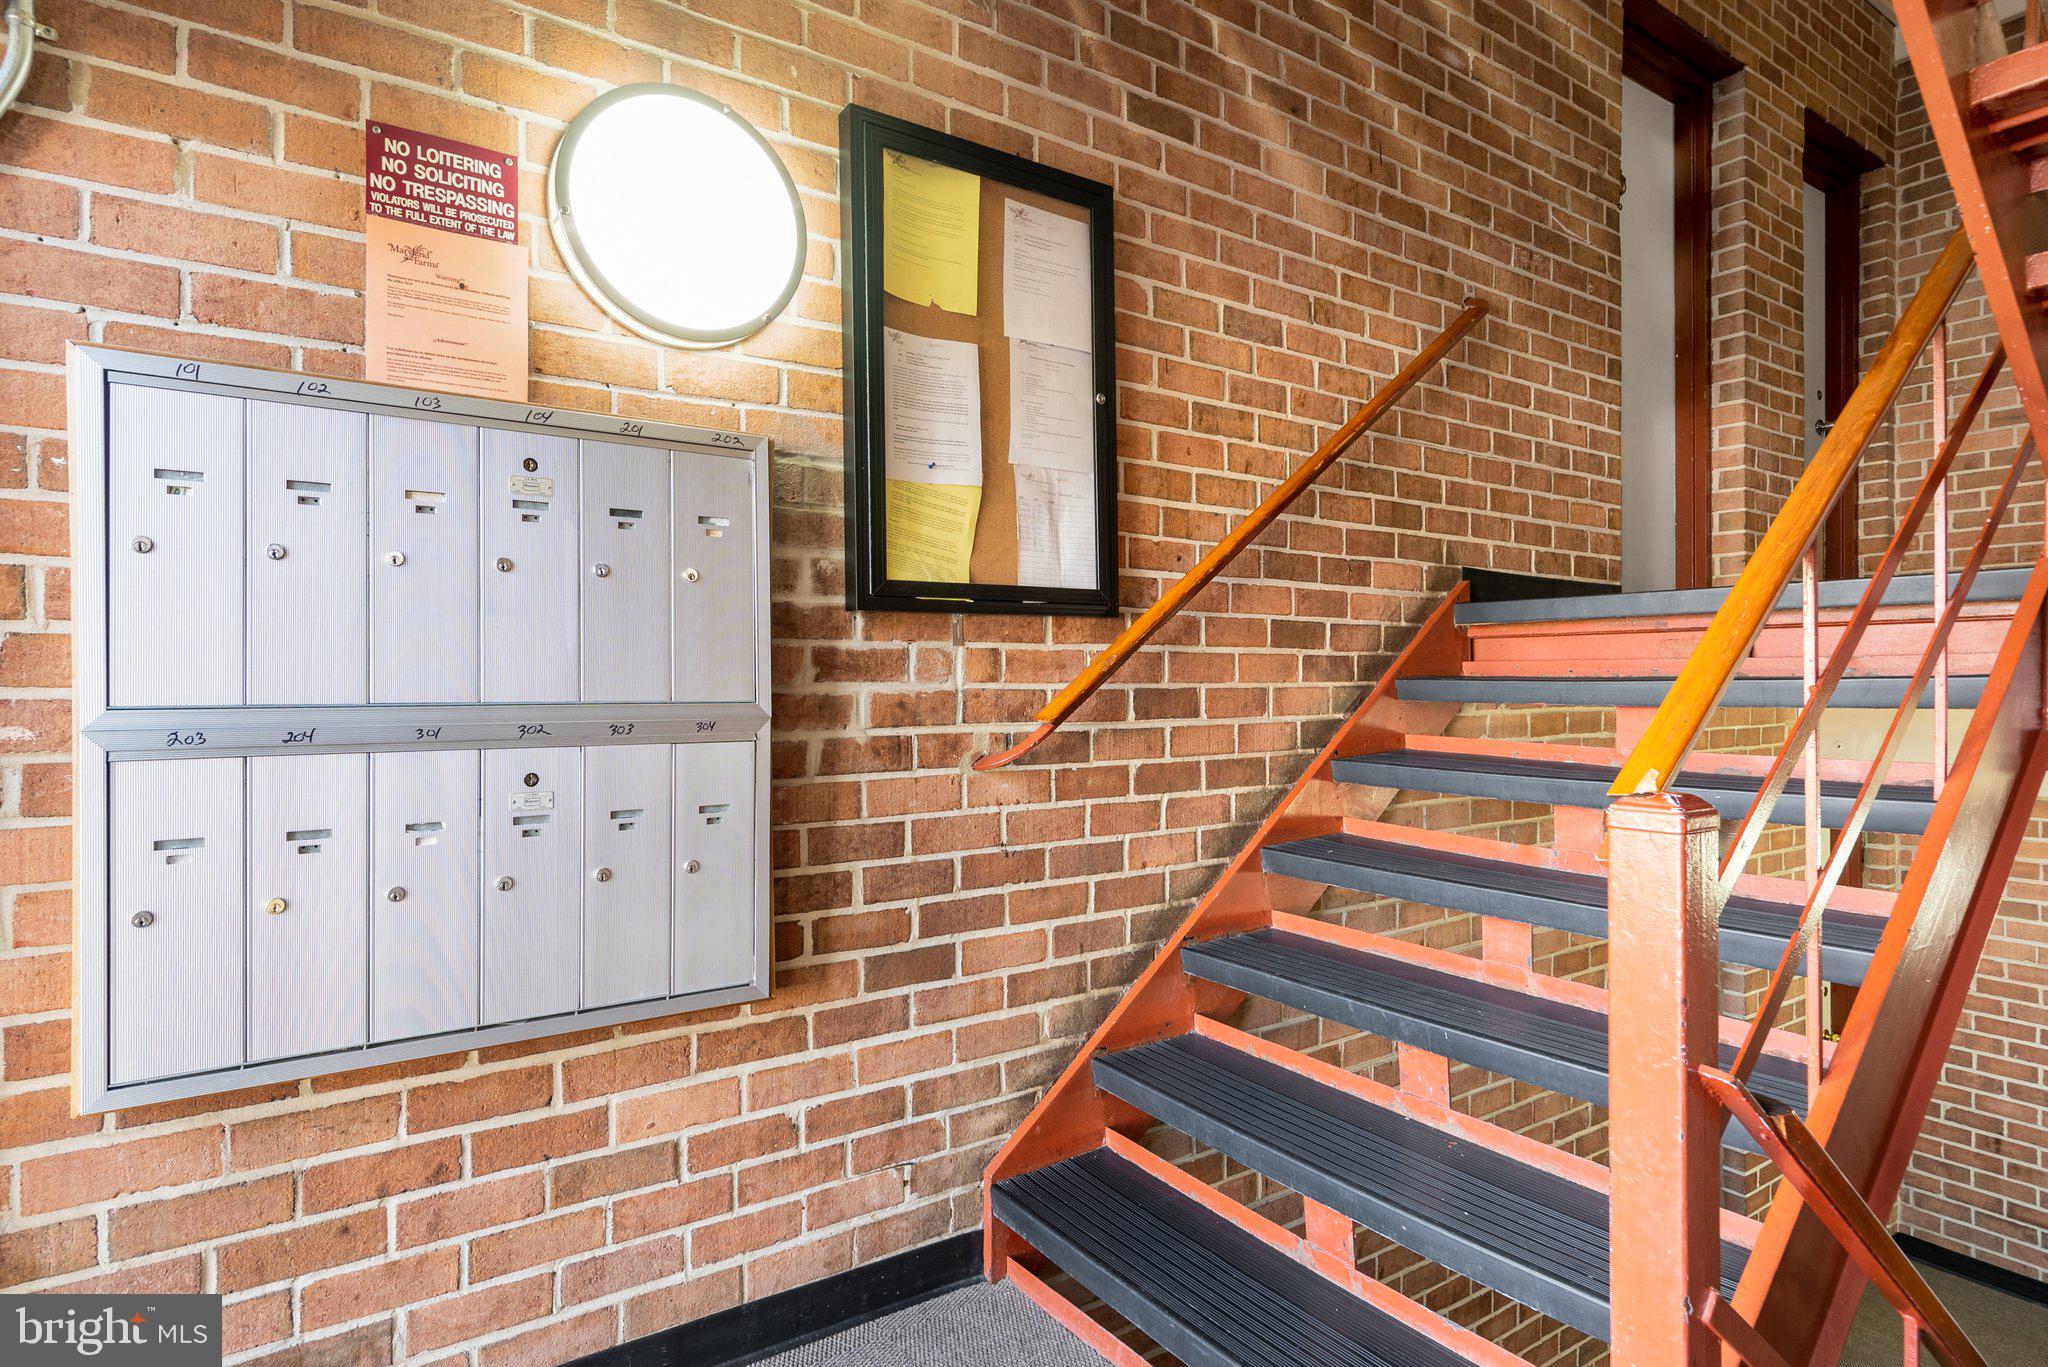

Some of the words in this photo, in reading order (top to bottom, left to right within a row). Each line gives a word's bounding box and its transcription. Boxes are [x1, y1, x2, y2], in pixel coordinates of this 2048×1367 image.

[384, 138, 410, 157] NO
[417, 145, 502, 179] LOITERING
[381, 156, 407, 175] NO
[414, 164, 504, 198] SOLICITING
[369, 172, 396, 191] NO
[402, 180, 515, 218] TRESPASSING
[371, 191, 420, 209] VIOLATORS
[422, 202, 443, 215] WILL
[445, 207, 457, 218] BE
[460, 211, 515, 230] PROSECUTED
[369, 202, 382, 213] TO
[385, 205, 402, 217] THE
[405, 210, 427, 222] FULL
[429, 215, 462, 230] EXTENT
[464, 222, 477, 232] OF
[479, 226, 495, 237] THE
[497, 229, 516, 241] LAW
[176, 362, 200, 380] 101
[297, 381, 331, 396] 102
[414, 396, 441, 410] 103
[525, 410, 554, 423] 104
[619, 422, 643, 436] 201
[711, 433, 744, 446] 202
[415, 727, 441, 739] 301
[518, 724, 551, 739] 302
[609, 723, 635, 735] 303
[696, 721, 716, 732] 304
[167, 731, 207, 746] 203
[282, 728, 316, 743] 204
